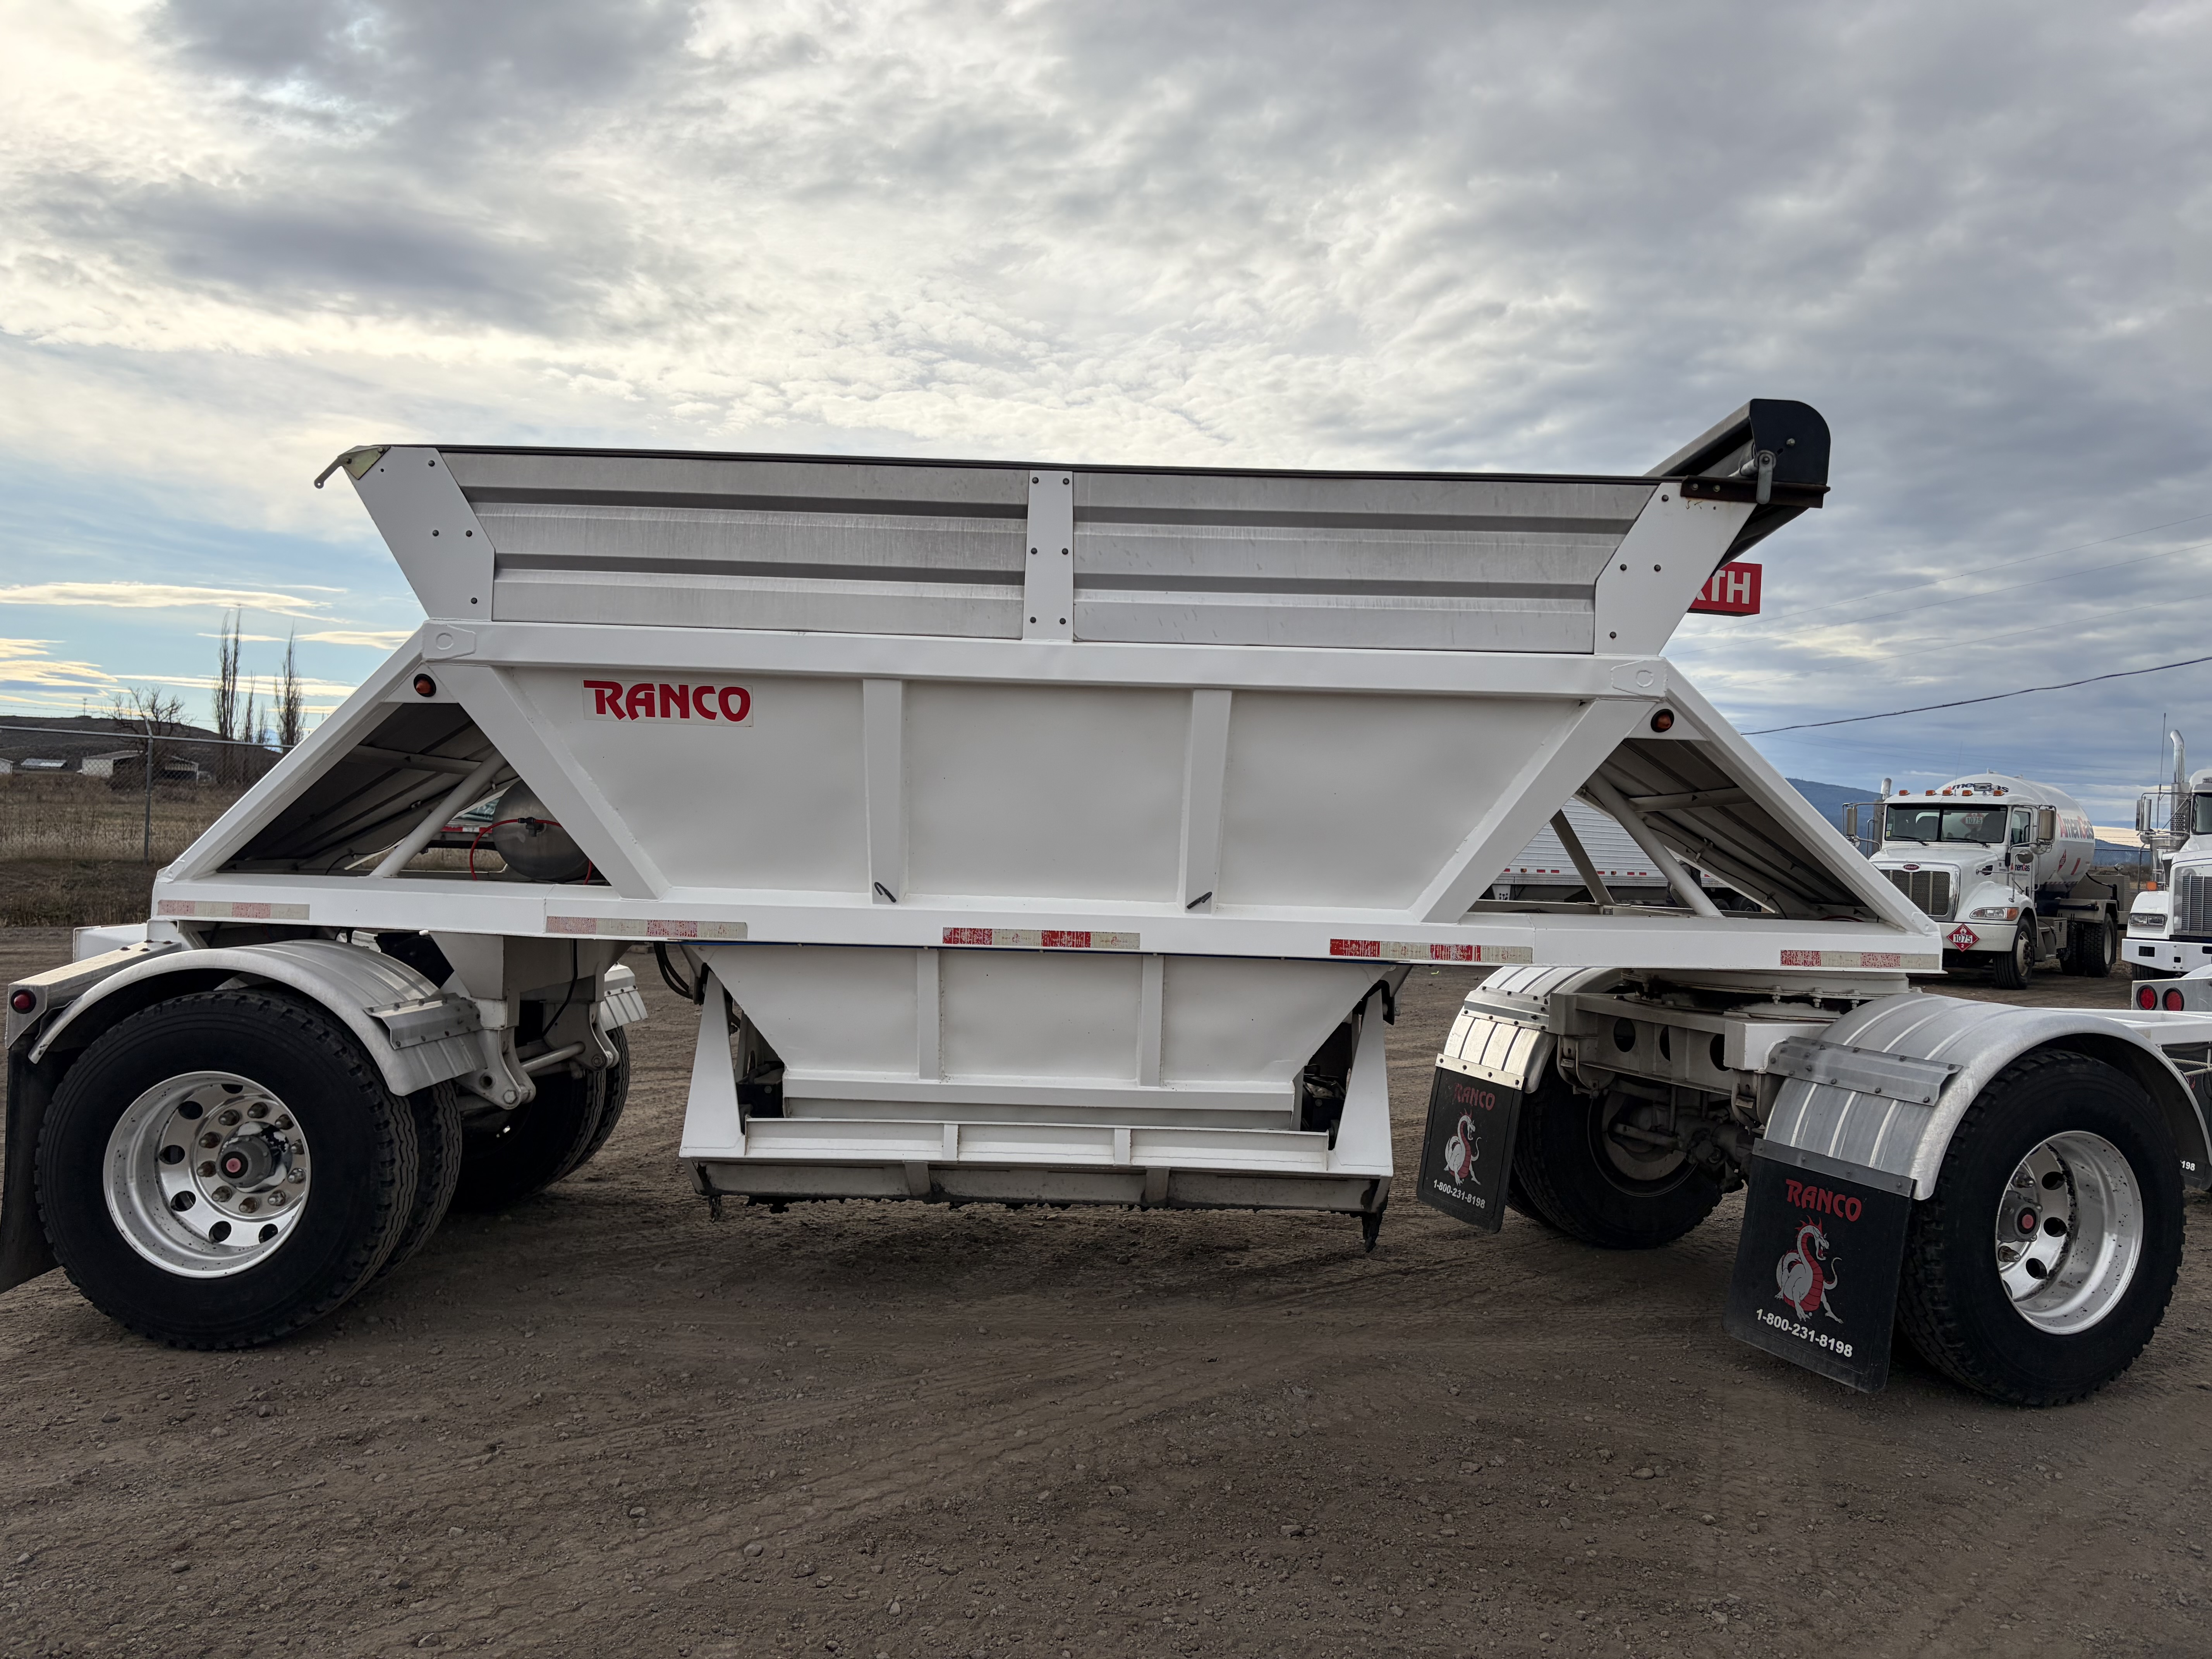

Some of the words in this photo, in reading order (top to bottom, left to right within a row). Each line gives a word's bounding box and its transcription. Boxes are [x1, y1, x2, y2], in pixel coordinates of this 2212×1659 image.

[583, 680, 750, 722] RANCO
[1954, 934, 1972, 943] 1075
[1454, 1083, 1496, 1111] RANCO
[2180, 1160, 2195, 1171] 198
[1433, 1179, 1486, 1209] 1-800-231-8198
[1786, 1179, 1862, 1221] RANCO
[1756, 1309, 1853, 1357] 1-800-231-8198
